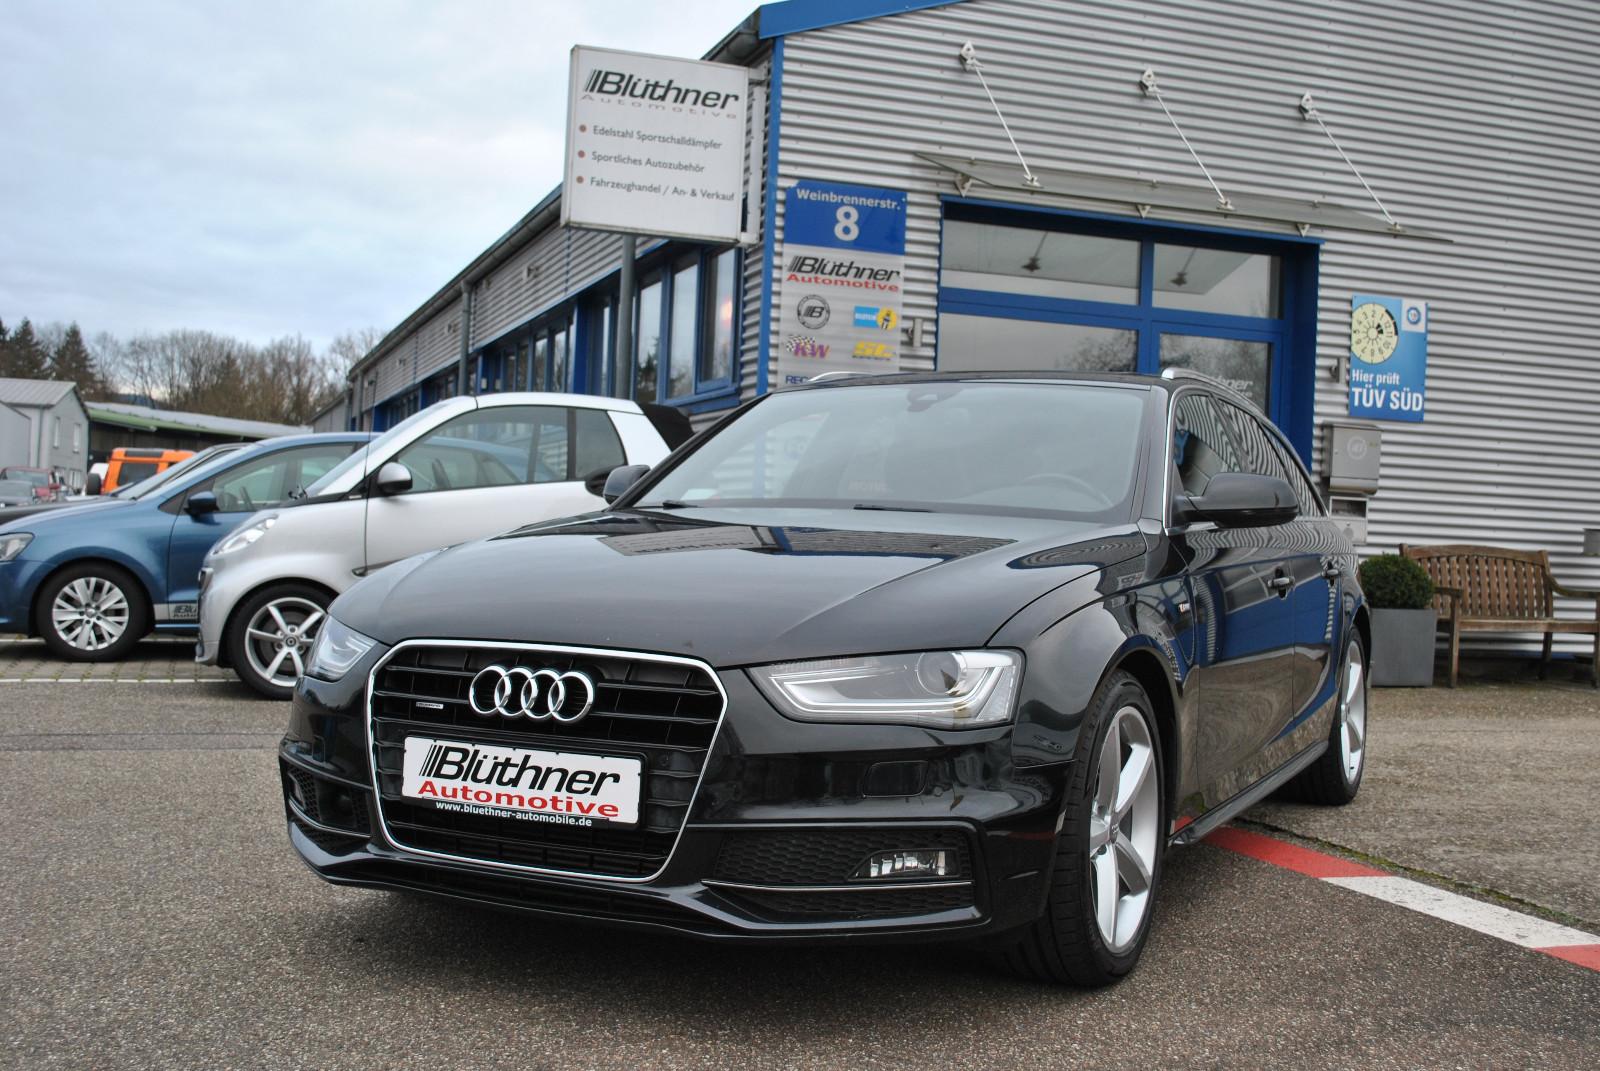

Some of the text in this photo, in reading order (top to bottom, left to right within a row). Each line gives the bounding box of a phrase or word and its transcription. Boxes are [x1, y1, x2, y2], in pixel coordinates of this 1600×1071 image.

[591, 69, 739, 109] Blüthner
[581, 94, 738, 119] Automotive
[593, 125, 722, 150] Edelstahl Sportschalldämpfer
[592, 151, 704, 172] Sportliches Autozubehör
[590, 177, 734, 201] Fahrzeughandel / An- & Verkauf
[796, 188, 901, 210] Weinbrennerstr.
[834, 205, 859, 242] 8
[793, 255, 900, 281] Blüthner
[787, 273, 899, 292] Automotive
[785, 376, 810, 385] REC
[1352, 369, 1400, 386] Hier prüft
[1352, 384, 1423, 412] TÜV SÜD
[425, 744, 620, 796] Blüthner
[418, 780, 619, 818] Automotive
[435, 801, 593, 827] www.bluethner-automobile.de
